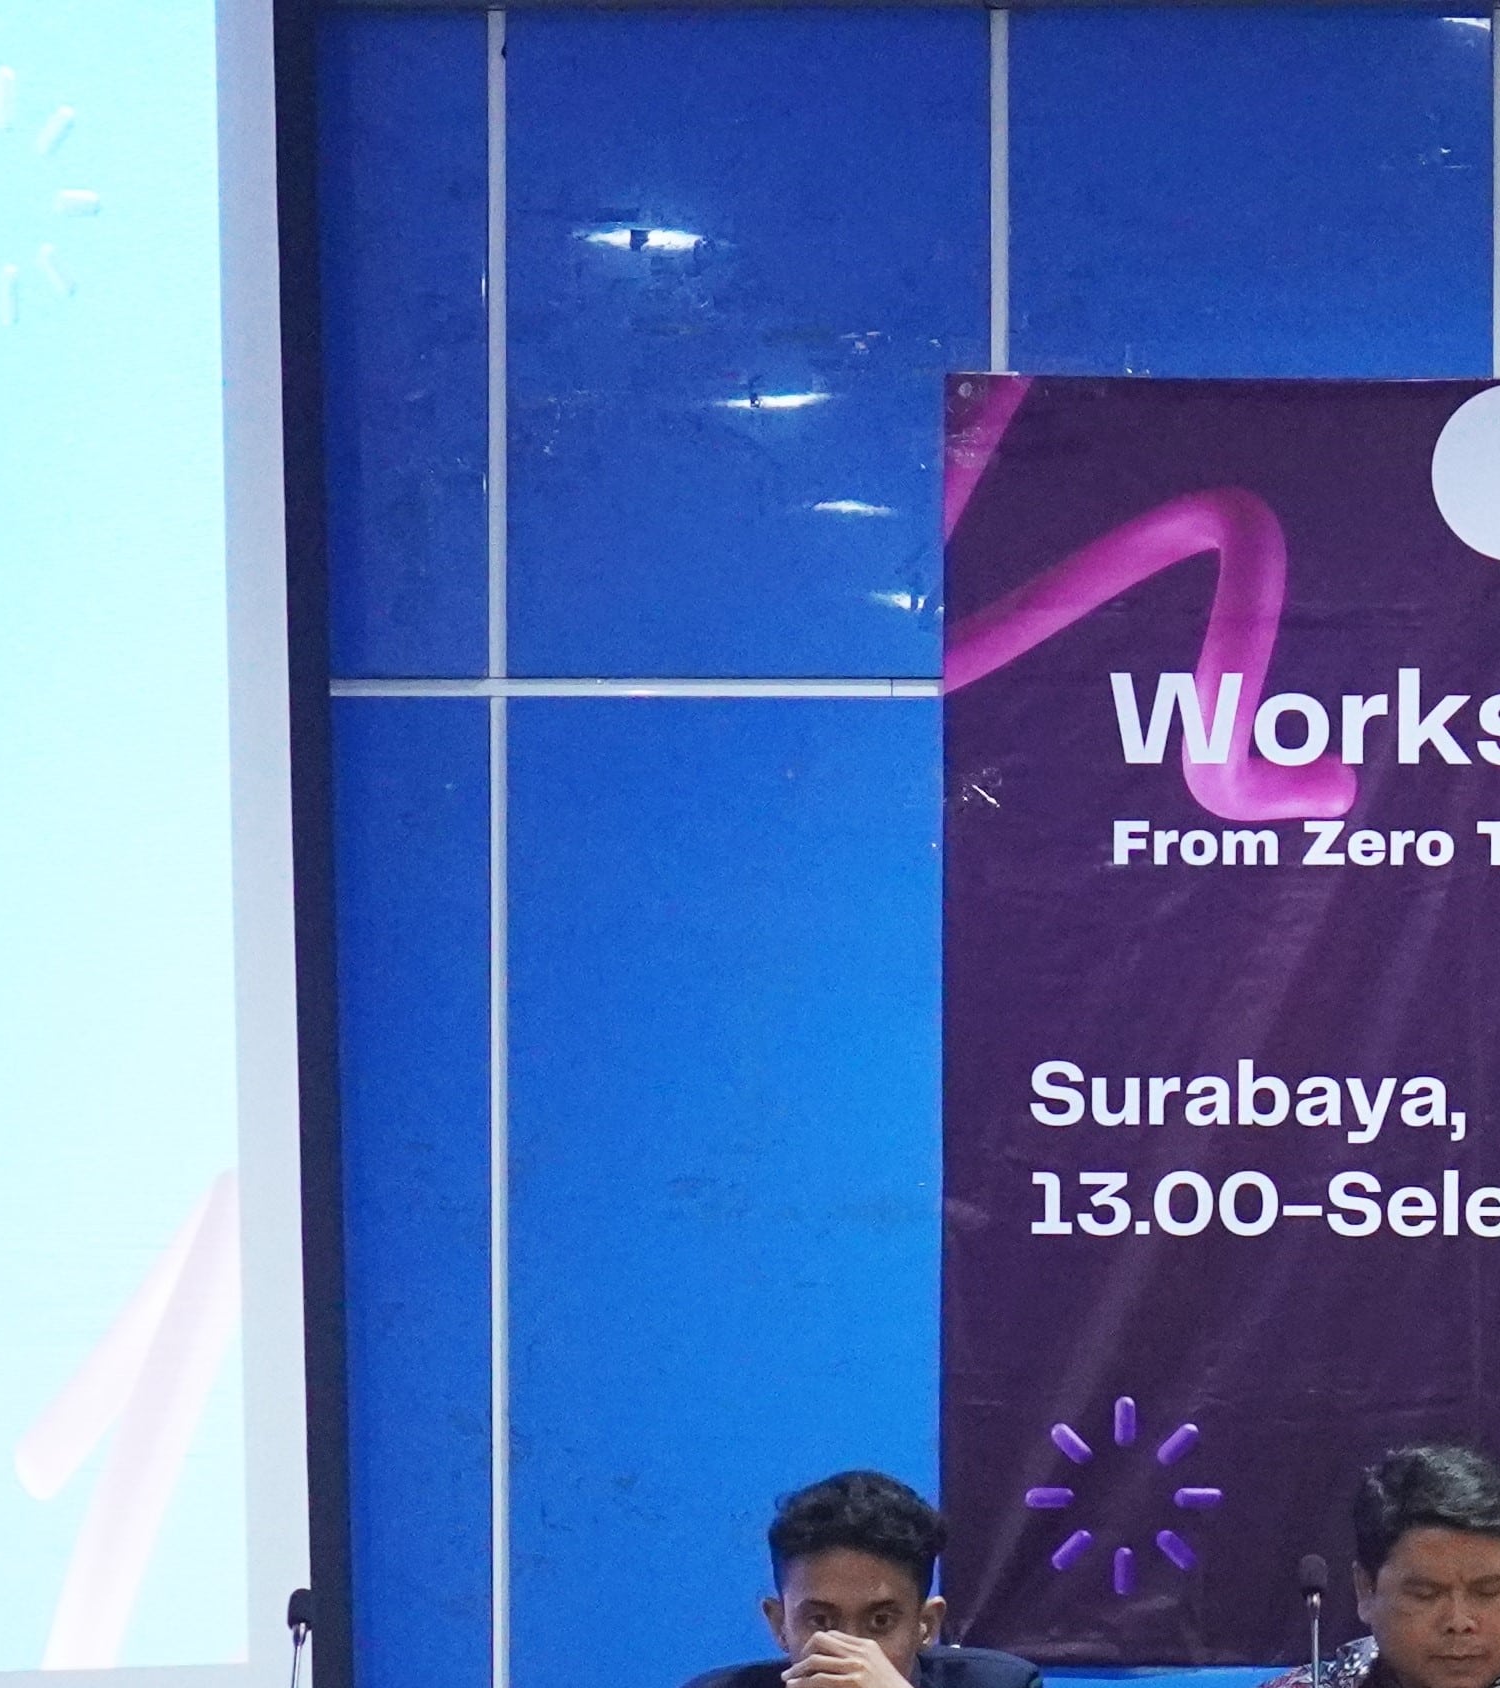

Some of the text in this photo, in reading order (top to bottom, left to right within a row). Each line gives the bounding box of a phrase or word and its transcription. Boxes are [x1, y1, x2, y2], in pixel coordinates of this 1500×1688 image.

[1112, 820, 1280, 867] From
[1301, 820, 1455, 867] Zero
[1029, 1059, 1468, 1144] Surabaya,
